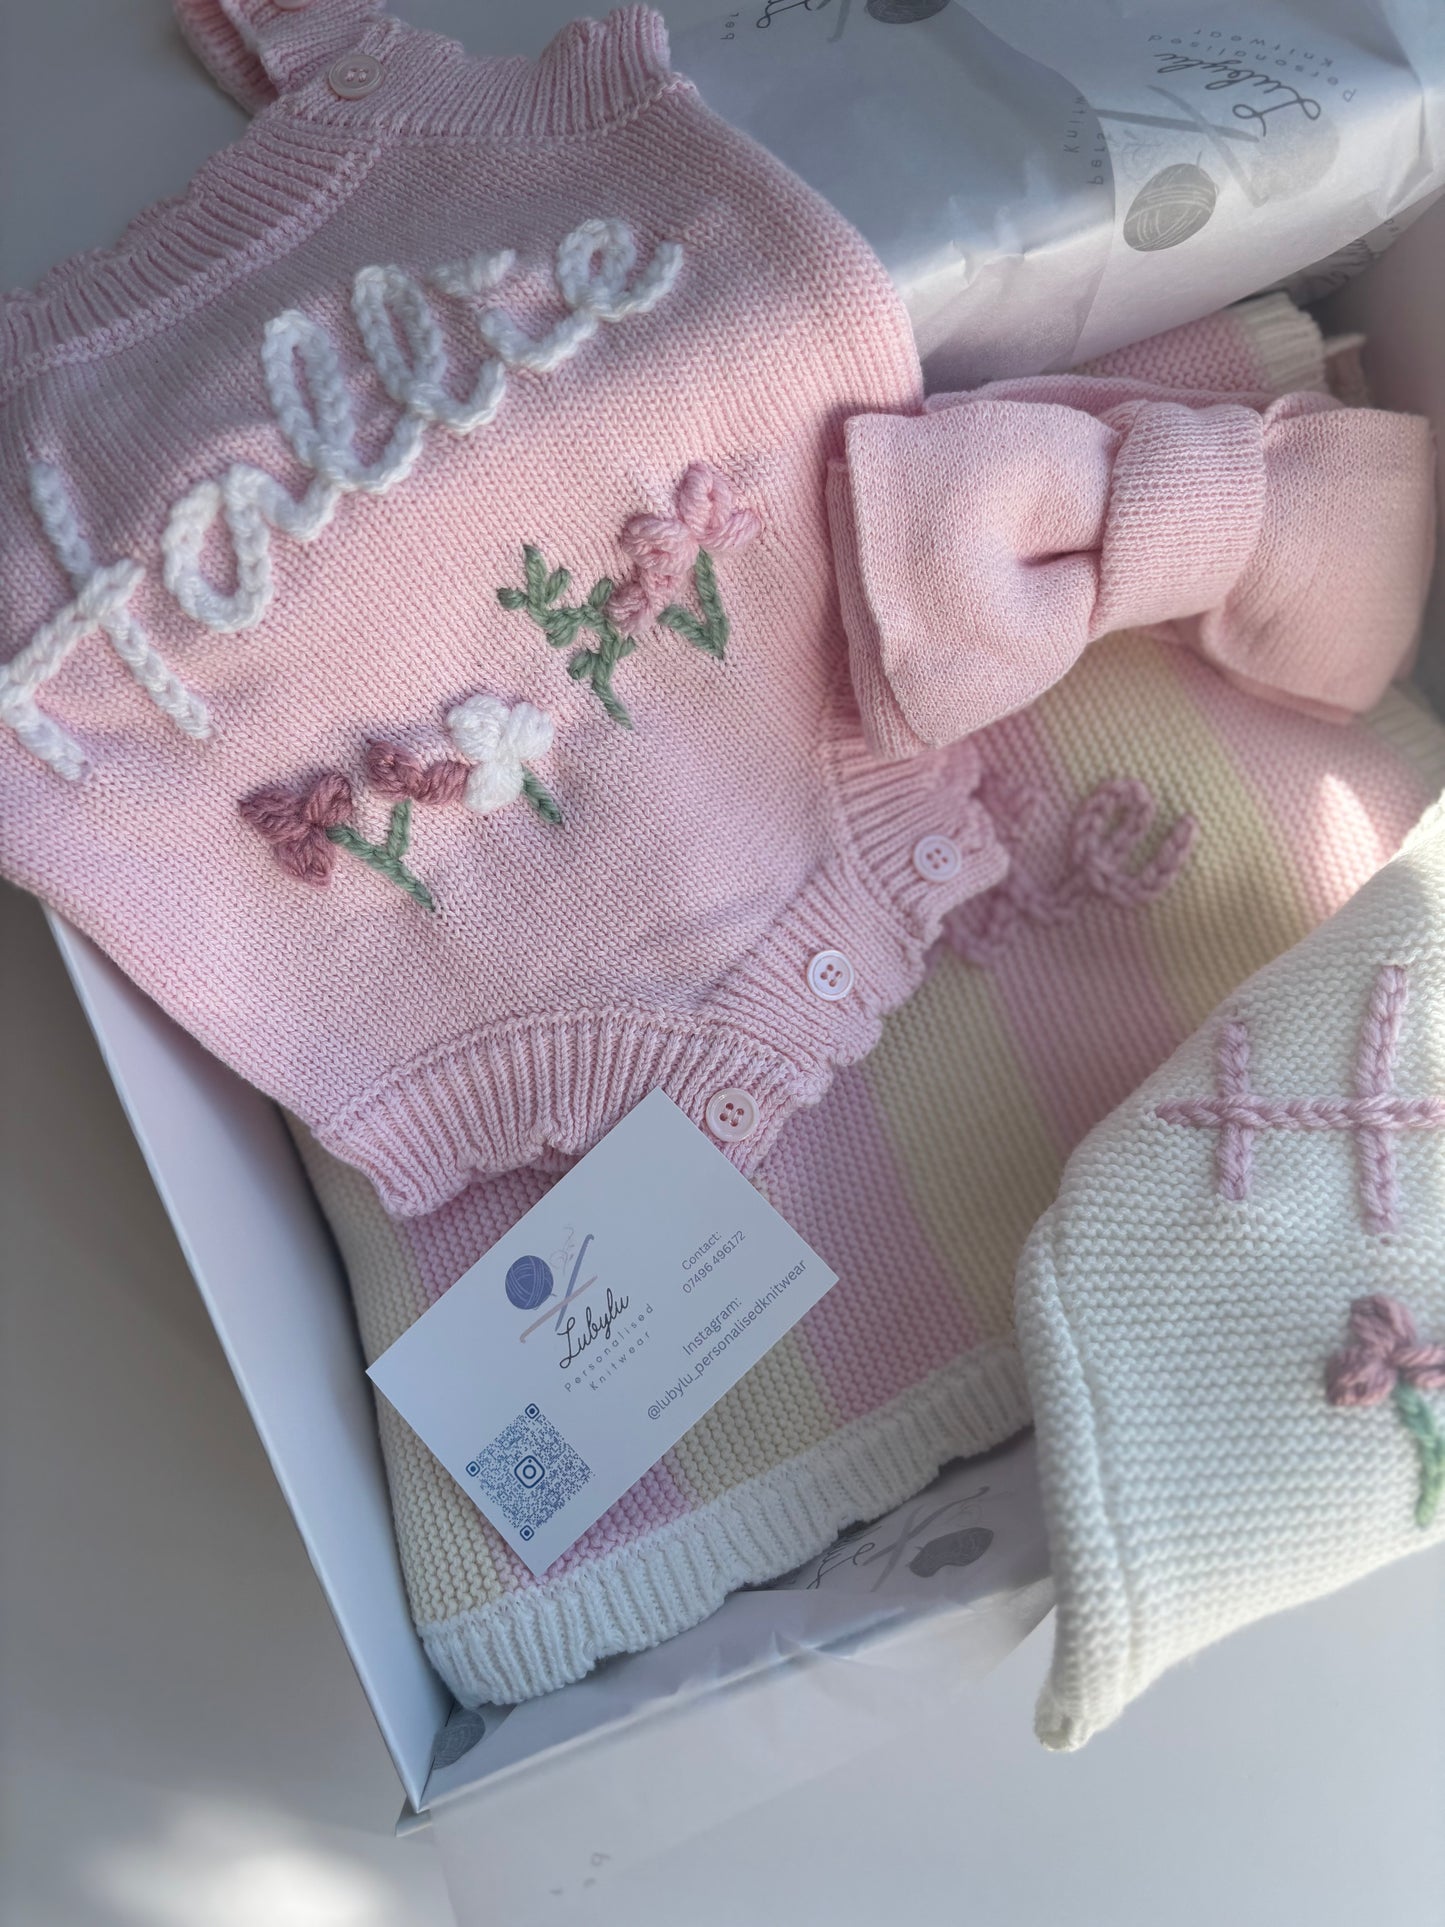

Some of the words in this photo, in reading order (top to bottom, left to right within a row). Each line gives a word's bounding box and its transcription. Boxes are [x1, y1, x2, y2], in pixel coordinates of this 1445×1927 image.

[1147, 34, 1357, 103] Personalised
[1193, 28, 1334, 68] Knitwear
[1153, 53, 1321, 137] Lubylu
[681, 1231, 722, 1271] Contact:
[682, 1261, 714, 1295] 07496
[712, 1230, 746, 1266] 496172
[556, 1287, 629, 1369] Lubylu
[563, 1303, 654, 1393] Personalised
[647, 1259, 808, 1421] @lubylu_personalisedknitwear
[682, 1296, 743, 1356] Instagram:
[589, 1331, 651, 1391] Knitwear
